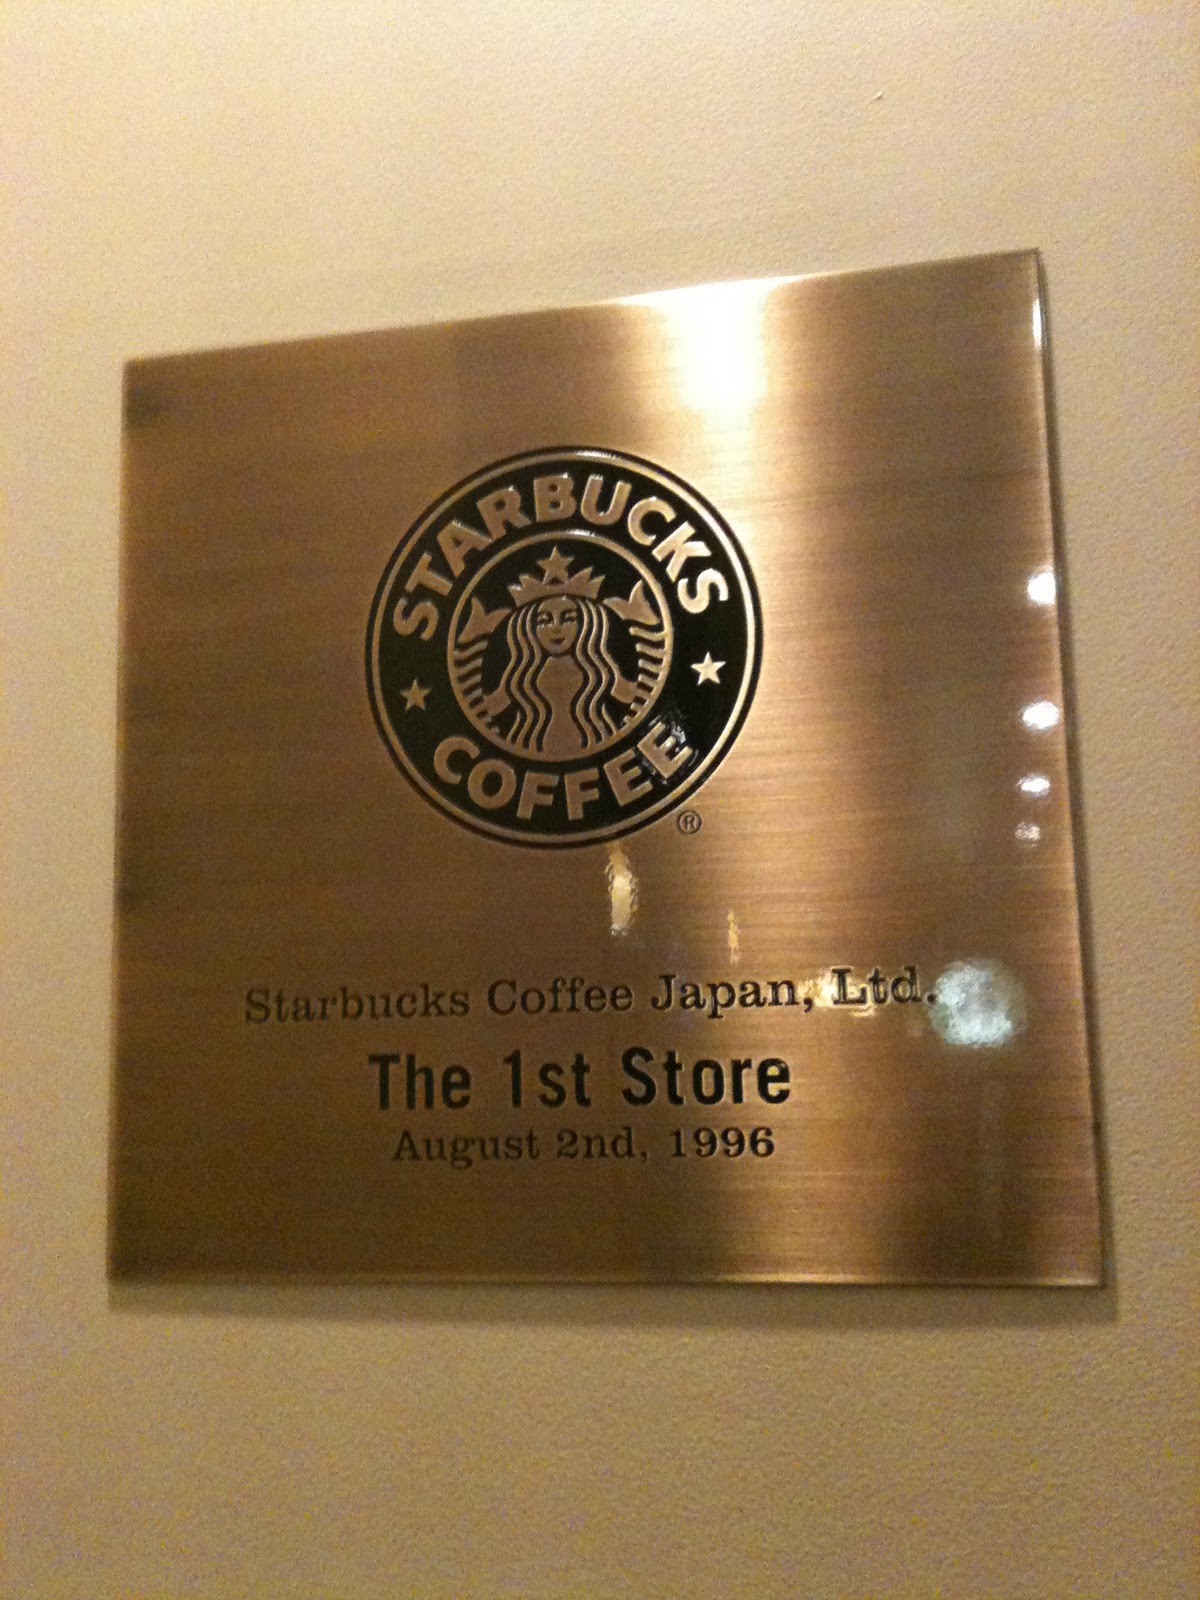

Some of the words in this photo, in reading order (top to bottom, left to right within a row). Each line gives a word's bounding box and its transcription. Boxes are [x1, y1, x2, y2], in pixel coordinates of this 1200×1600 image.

[393, 472, 729, 641] STARBUCKS
[432, 721, 692, 821] COFFEE
[244, 982, 471, 1024] Starbucks
[486, 976, 634, 1017] Coffee
[650, 973, 814, 1020] Japan,
[830, 965, 938, 1005] Ltd.
[367, 1052, 473, 1112] The
[503, 1048, 592, 1109] 1st
[620, 1045, 792, 1106] Store
[391, 1128, 541, 1170] August
[555, 1125, 648, 1160] 2nd,
[669, 1125, 776, 1159] 1996
